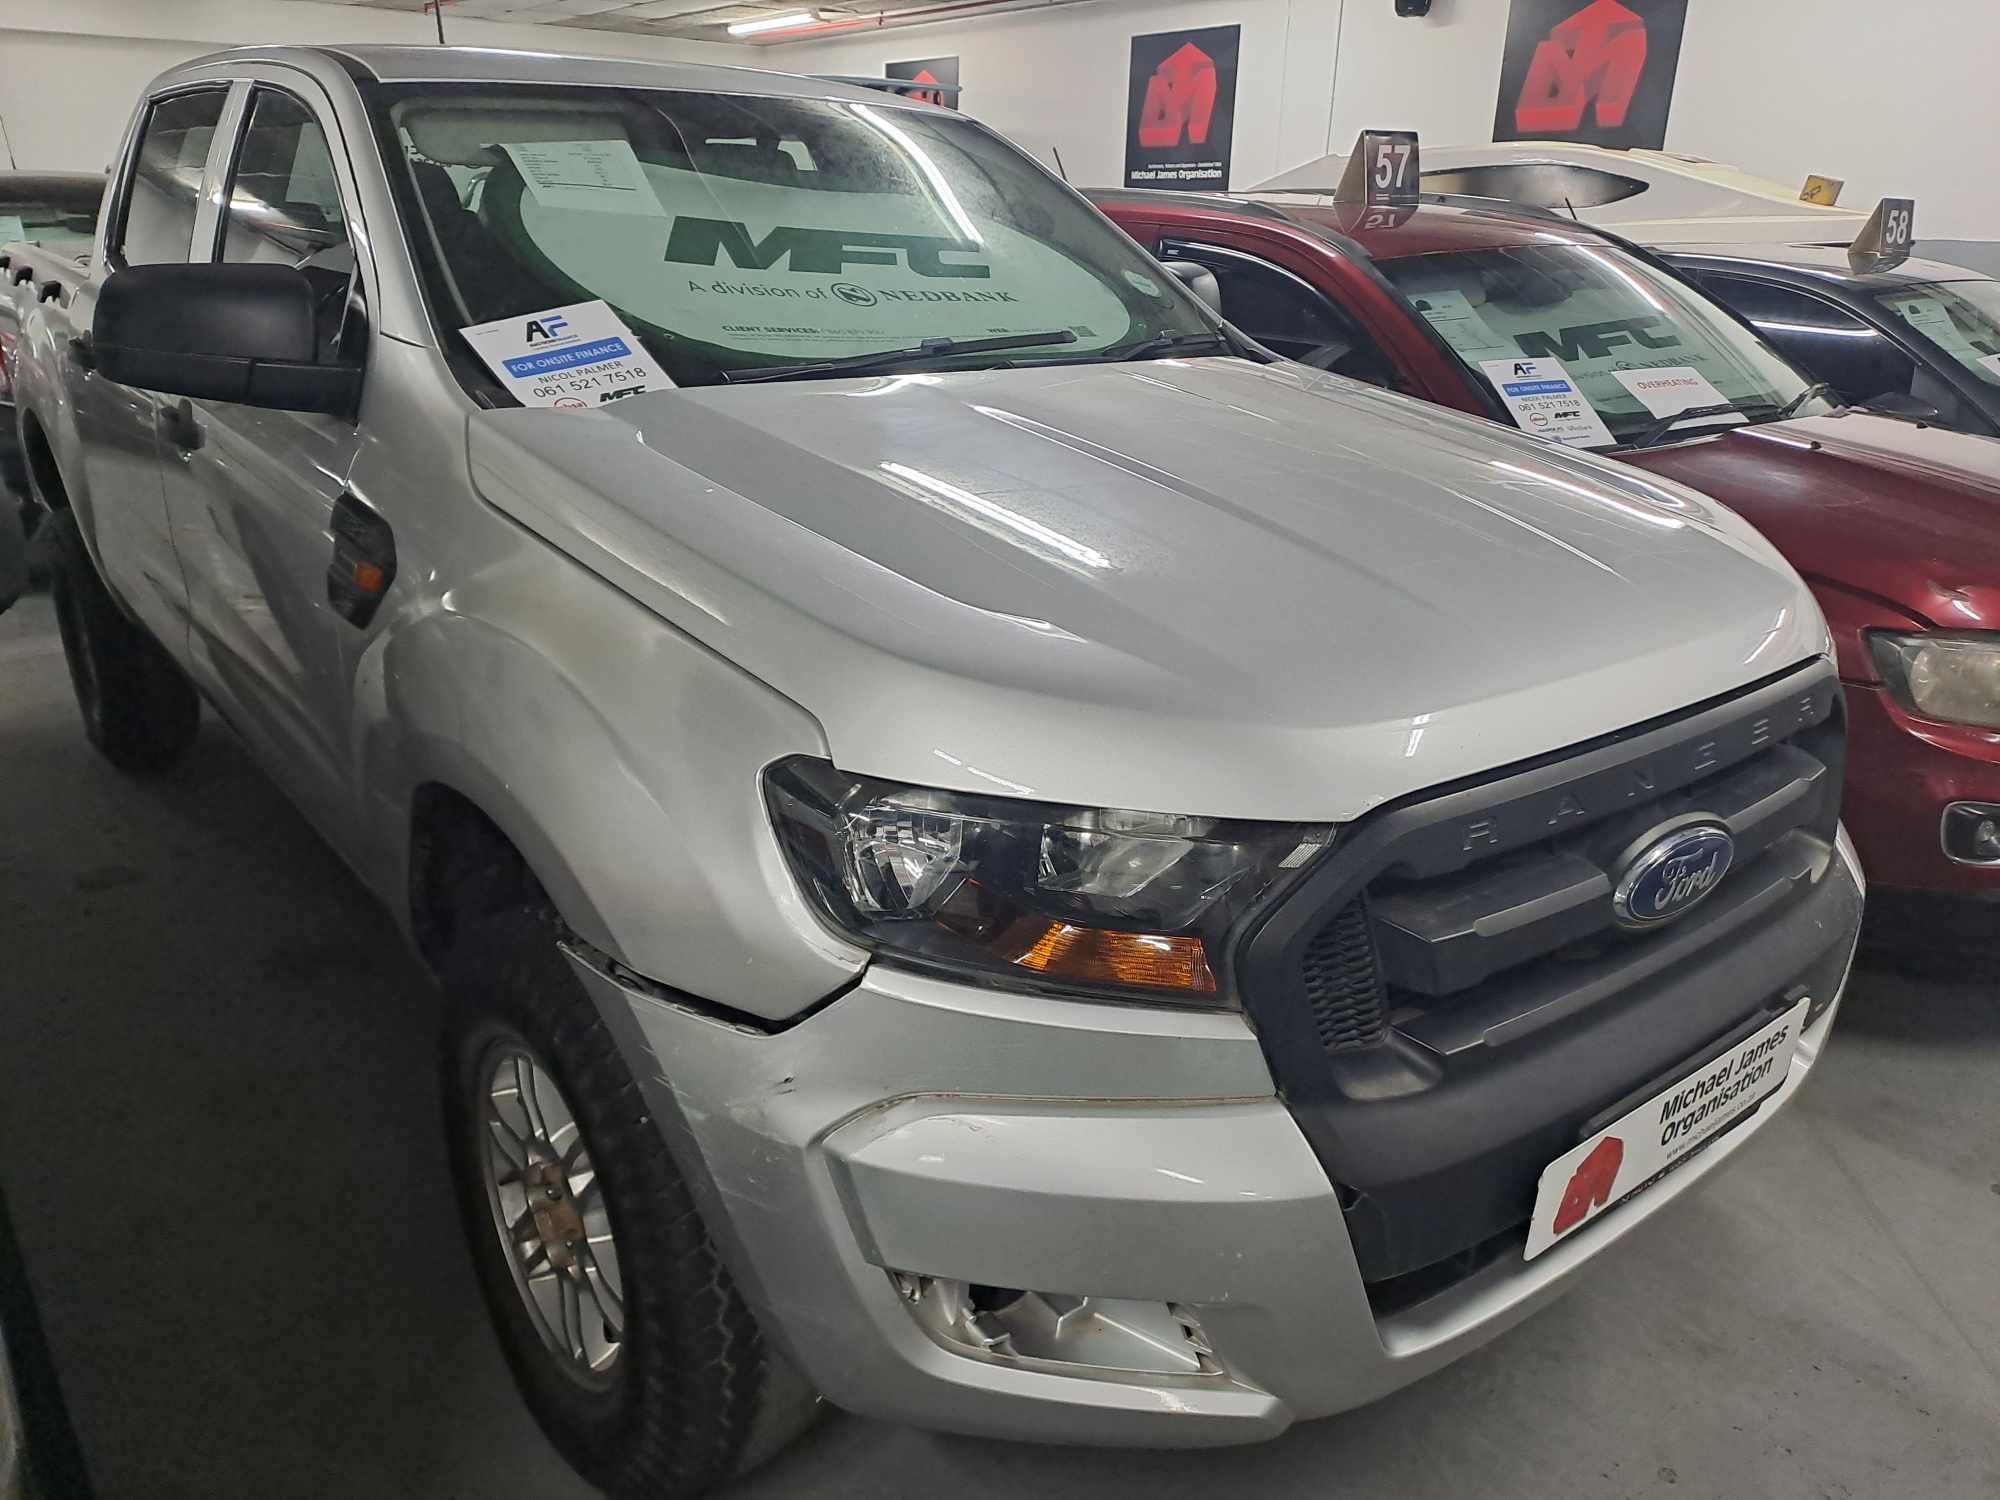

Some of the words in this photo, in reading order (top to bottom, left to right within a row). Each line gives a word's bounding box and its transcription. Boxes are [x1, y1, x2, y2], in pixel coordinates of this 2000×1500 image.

[1131, 170, 1155, 179] Michael
[1156, 170, 1178, 179] James
[1178, 169, 1222, 180] Organisation
[1375, 144, 1411, 188] 57
[1885, 209, 1909, 244] 58
[664, 215, 990, 279] MFC
[688, 280, 705, 293] A
[712, 281, 799, 299] division
[805, 286, 828, 300] of
[880, 289, 1020, 304] NEDBANK
[1513, 316, 1682, 361] MFC
[511, 361, 533, 373] FOR
[536, 353, 573, 369] ONSITE
[575, 343, 624, 360] FINANCE
[538, 371, 573, 384] NICOL
[578, 360, 623, 376] PALMER
[533, 384, 565, 398] 061
[570, 377, 601, 391] 521
[605, 367, 647, 385] 7518
[600, 385, 646, 402] MFC
[1637, 378, 1698, 389] OVERHEATING
[1519, 403, 1536, 412] 061
[1538, 401, 1554, 410] 521
[1558, 400, 1581, 409] 7518
[1554, 411, 1581, 419] MFC
[1463, 697, 1816, 851] RANGER
[1654, 848, 1719, 910] Ford
[1659, 1059, 1733, 1125] Michael
[1734, 1025, 1789, 1077] James
[1661, 1056, 1774, 1146] Organisation
